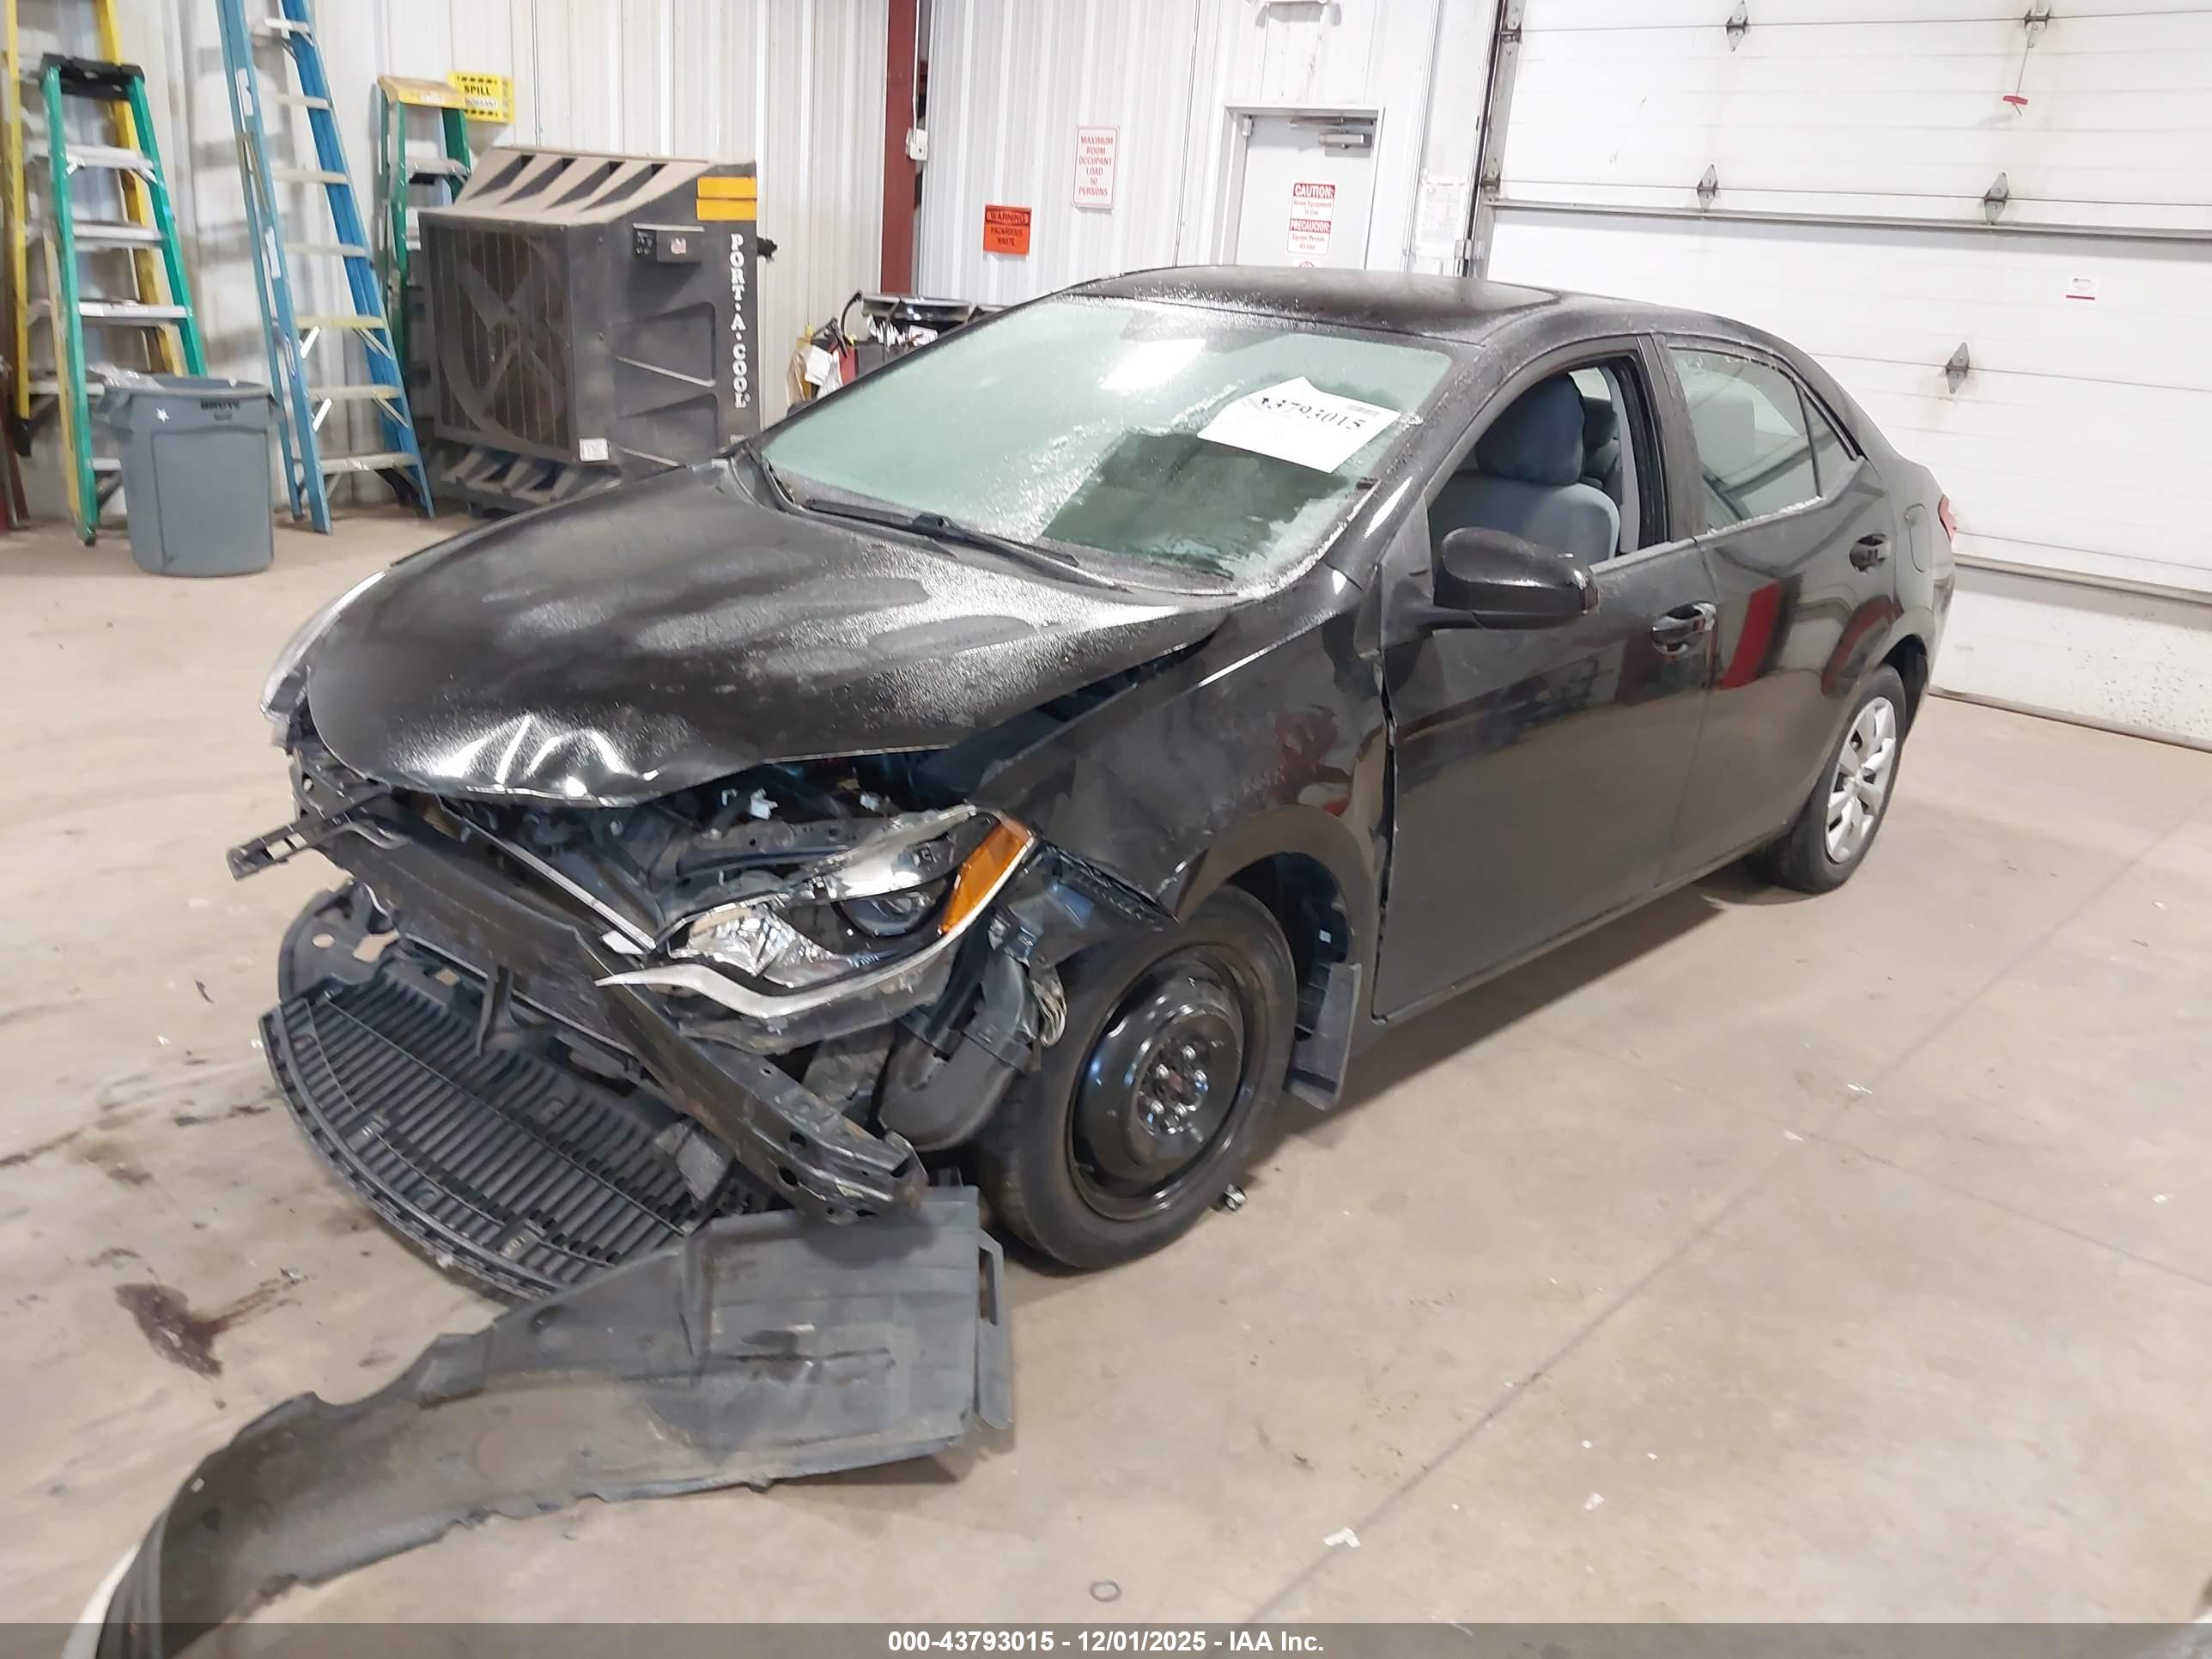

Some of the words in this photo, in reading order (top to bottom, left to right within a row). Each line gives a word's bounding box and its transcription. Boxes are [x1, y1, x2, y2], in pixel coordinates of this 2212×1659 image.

[465, 85, 491, 96] SPILL
[1080, 136, 1114, 144] MAXIMUM
[1086, 146, 1106, 155] ROOM
[1079, 156, 1112, 165] OCCUPANT
[1086, 167, 1103, 176] LOAD
[1079, 186, 1108, 197] PERSONS
[987, 210, 1029, 223] WARNING
